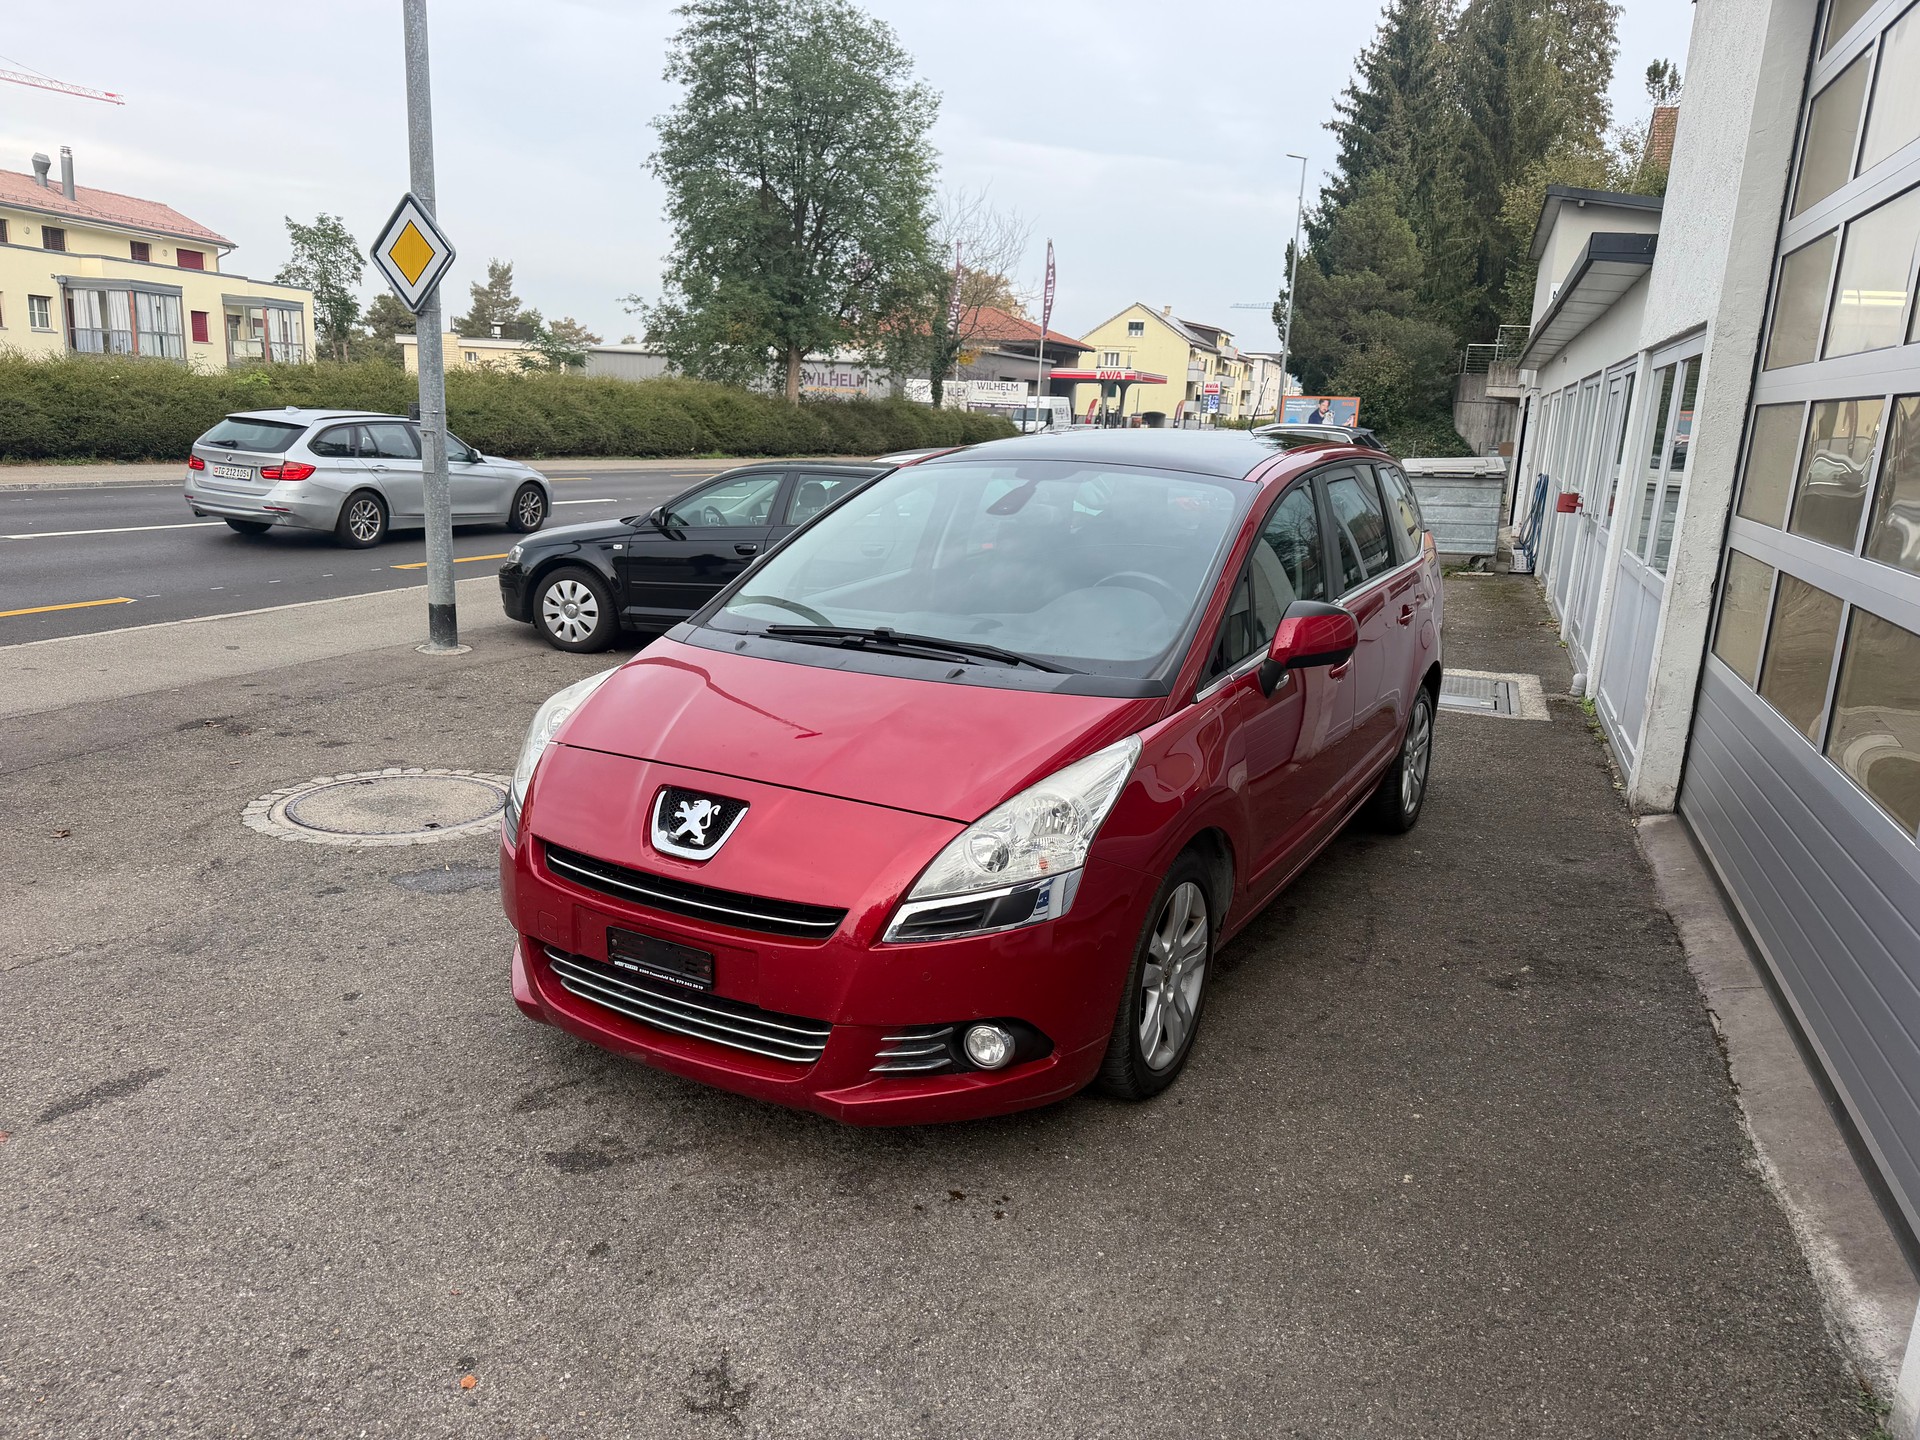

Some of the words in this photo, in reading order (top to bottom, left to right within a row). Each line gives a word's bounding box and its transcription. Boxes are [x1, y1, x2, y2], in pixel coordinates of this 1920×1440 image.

[803, 372, 867, 387] WILHELM
[1099, 371, 1122, 380] AVIA
[976, 382, 1019, 391] WILHELM
